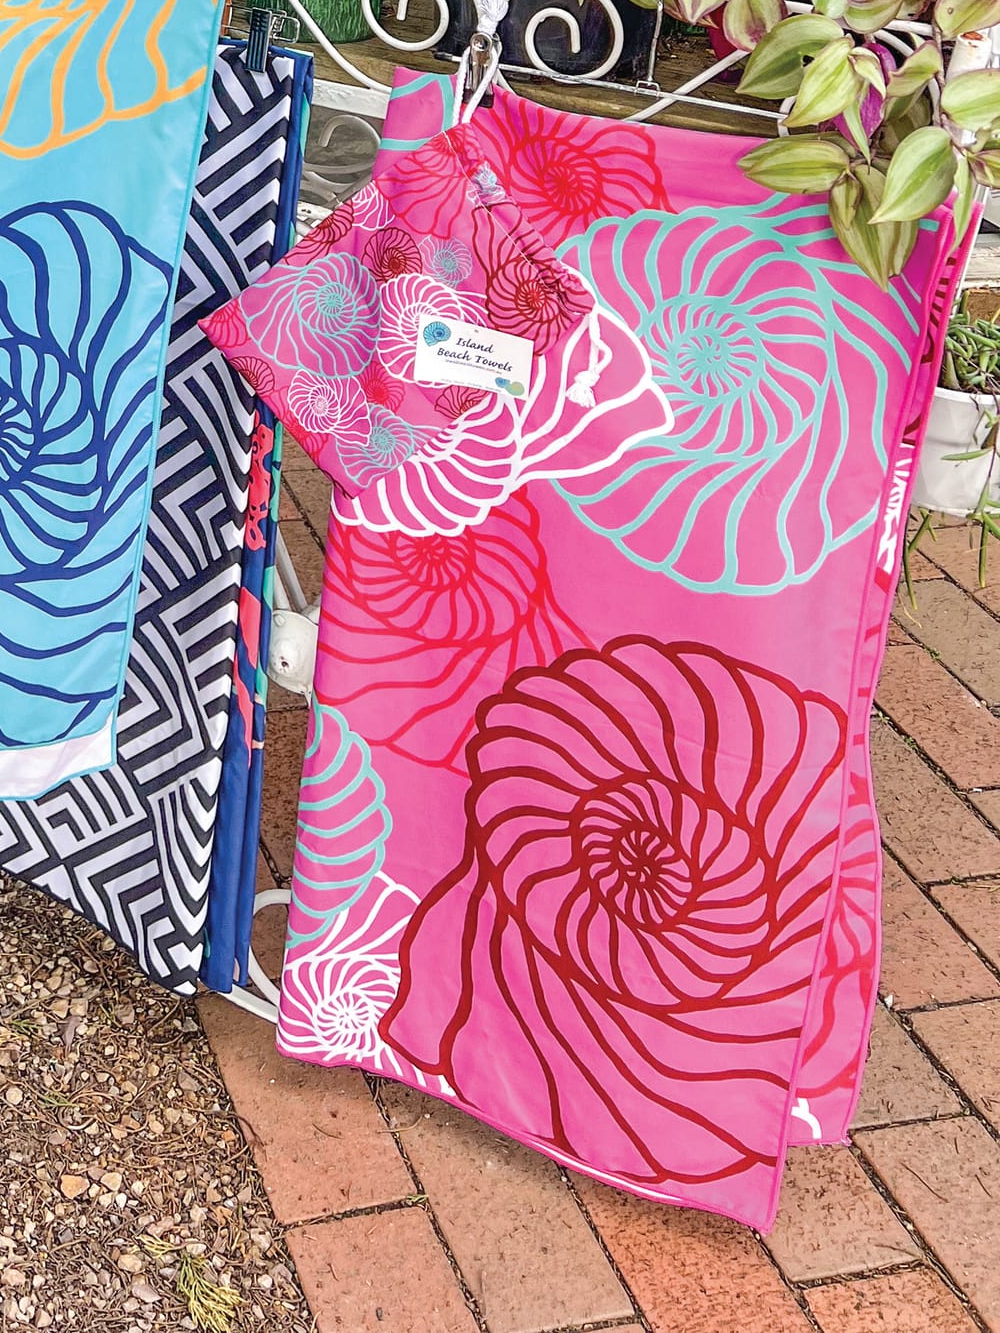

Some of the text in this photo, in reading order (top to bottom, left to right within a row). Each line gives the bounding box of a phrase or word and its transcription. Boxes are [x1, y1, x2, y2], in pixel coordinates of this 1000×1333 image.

[456, 337, 494, 354] Island
[437, 347, 472, 362] Beach
[475, 354, 513, 372] Towels
